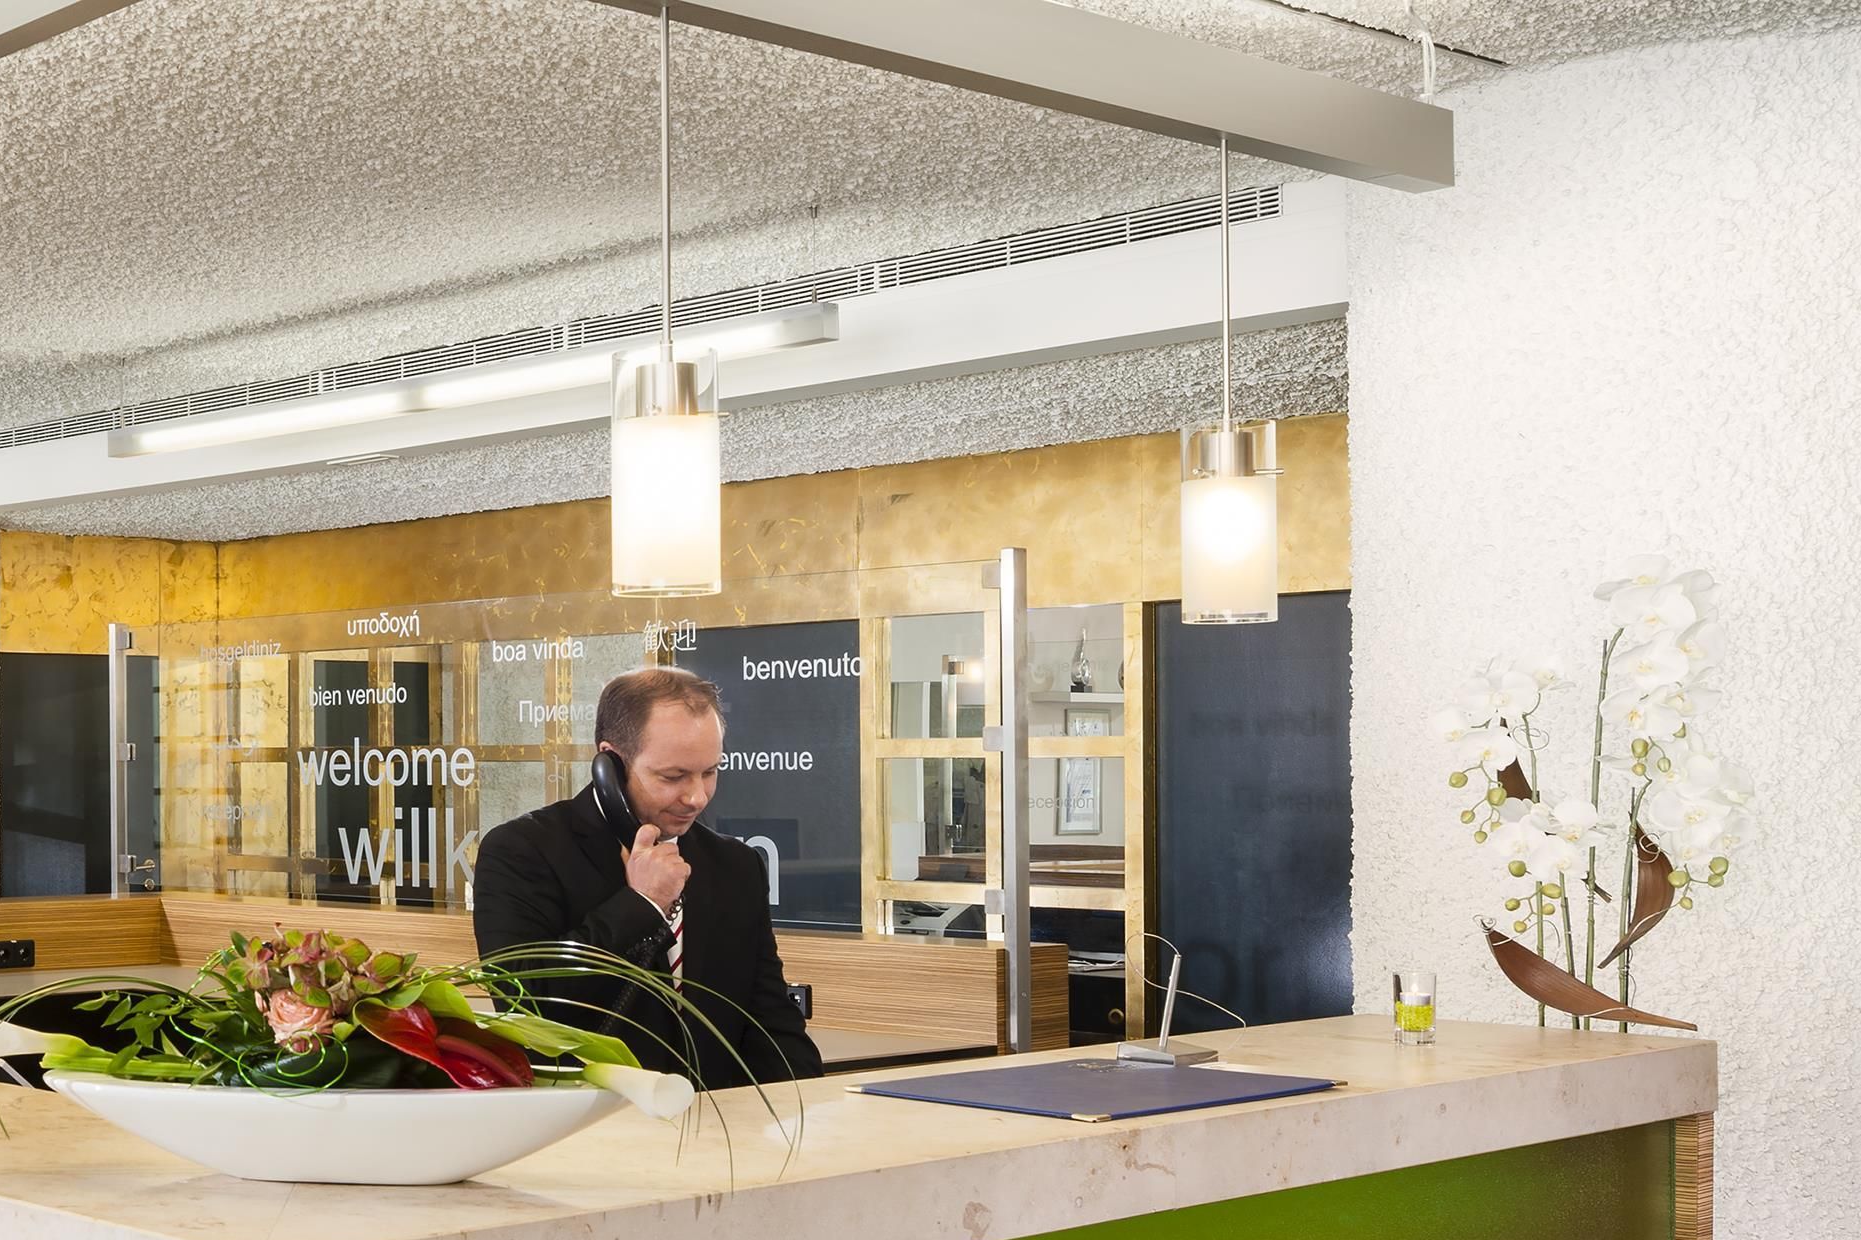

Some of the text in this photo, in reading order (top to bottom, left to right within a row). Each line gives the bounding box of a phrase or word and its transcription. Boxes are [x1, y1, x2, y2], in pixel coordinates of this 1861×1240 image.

[347, 609, 420, 637] υποδοχή
[492, 635, 584, 662] boa vinda
[309, 682, 408, 706] bien venudo
[297, 737, 475, 787] welcome
[716, 750, 813, 771] envenue
